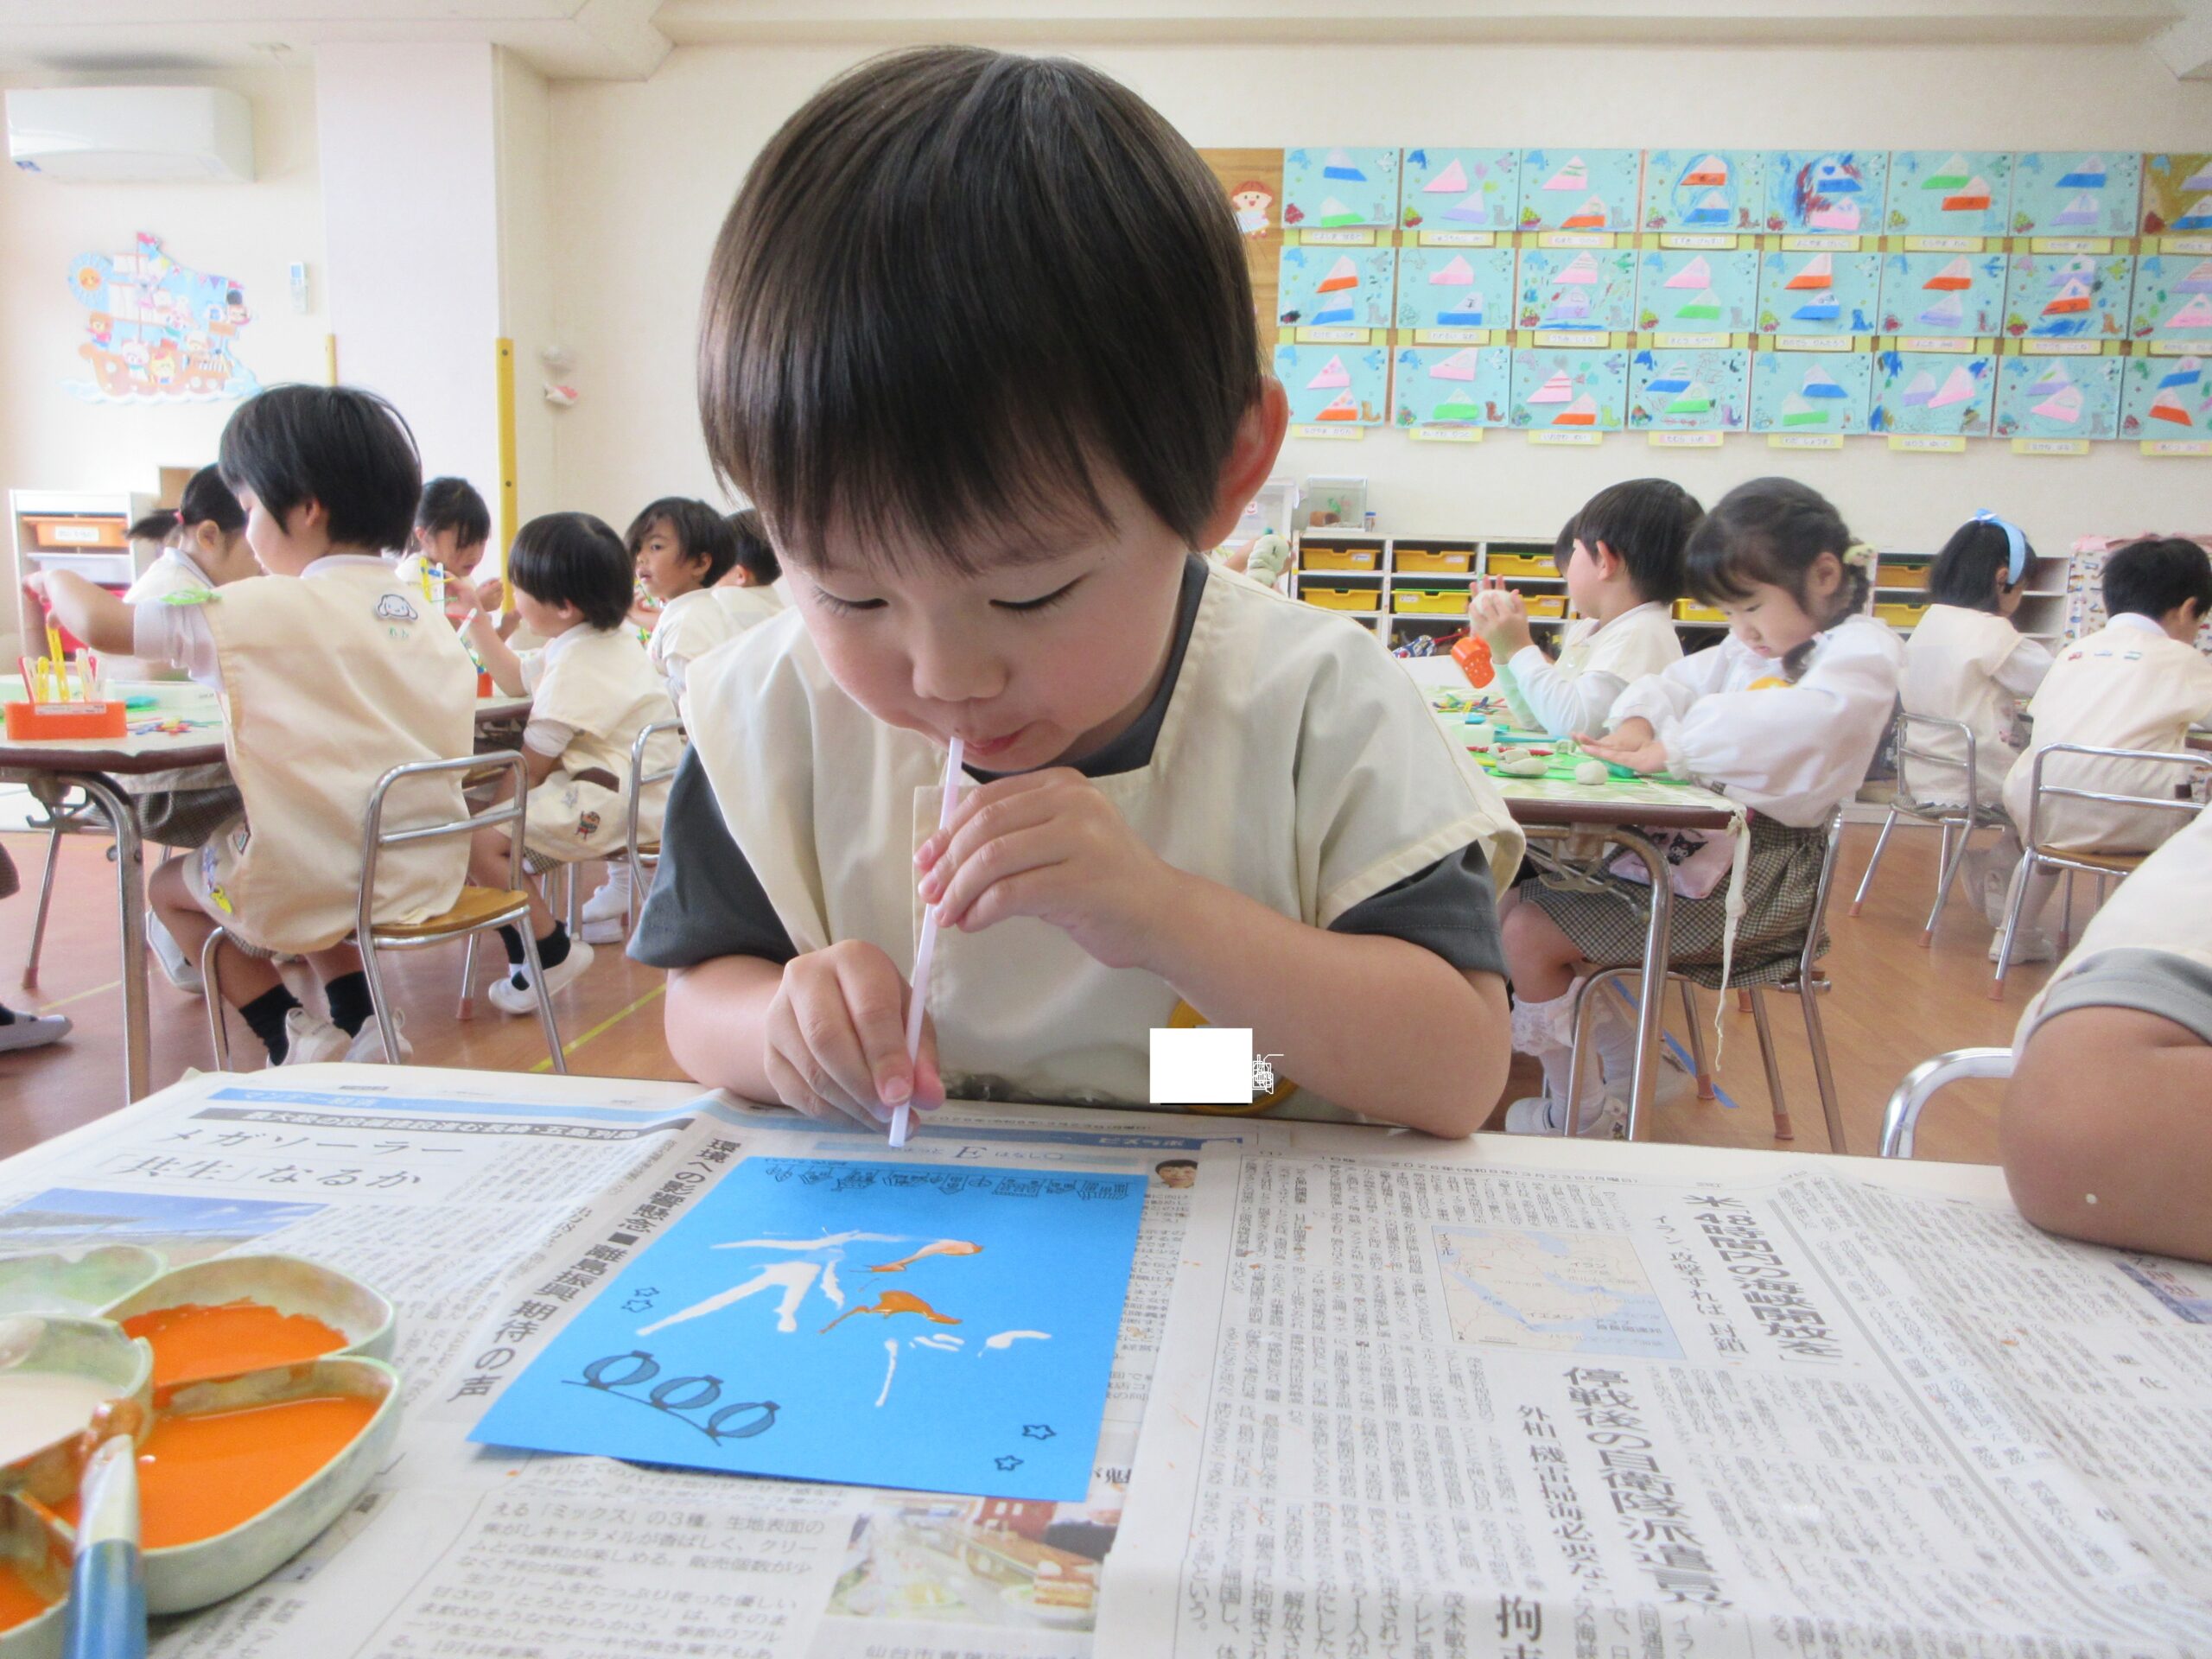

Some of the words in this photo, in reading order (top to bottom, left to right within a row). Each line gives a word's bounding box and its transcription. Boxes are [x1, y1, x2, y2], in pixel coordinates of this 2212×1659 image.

[153, 1128, 464, 1155] メガソーラー
[954, 1146, 988, 1160] E
[96, 1154, 421, 1189] 「共生」なるか
